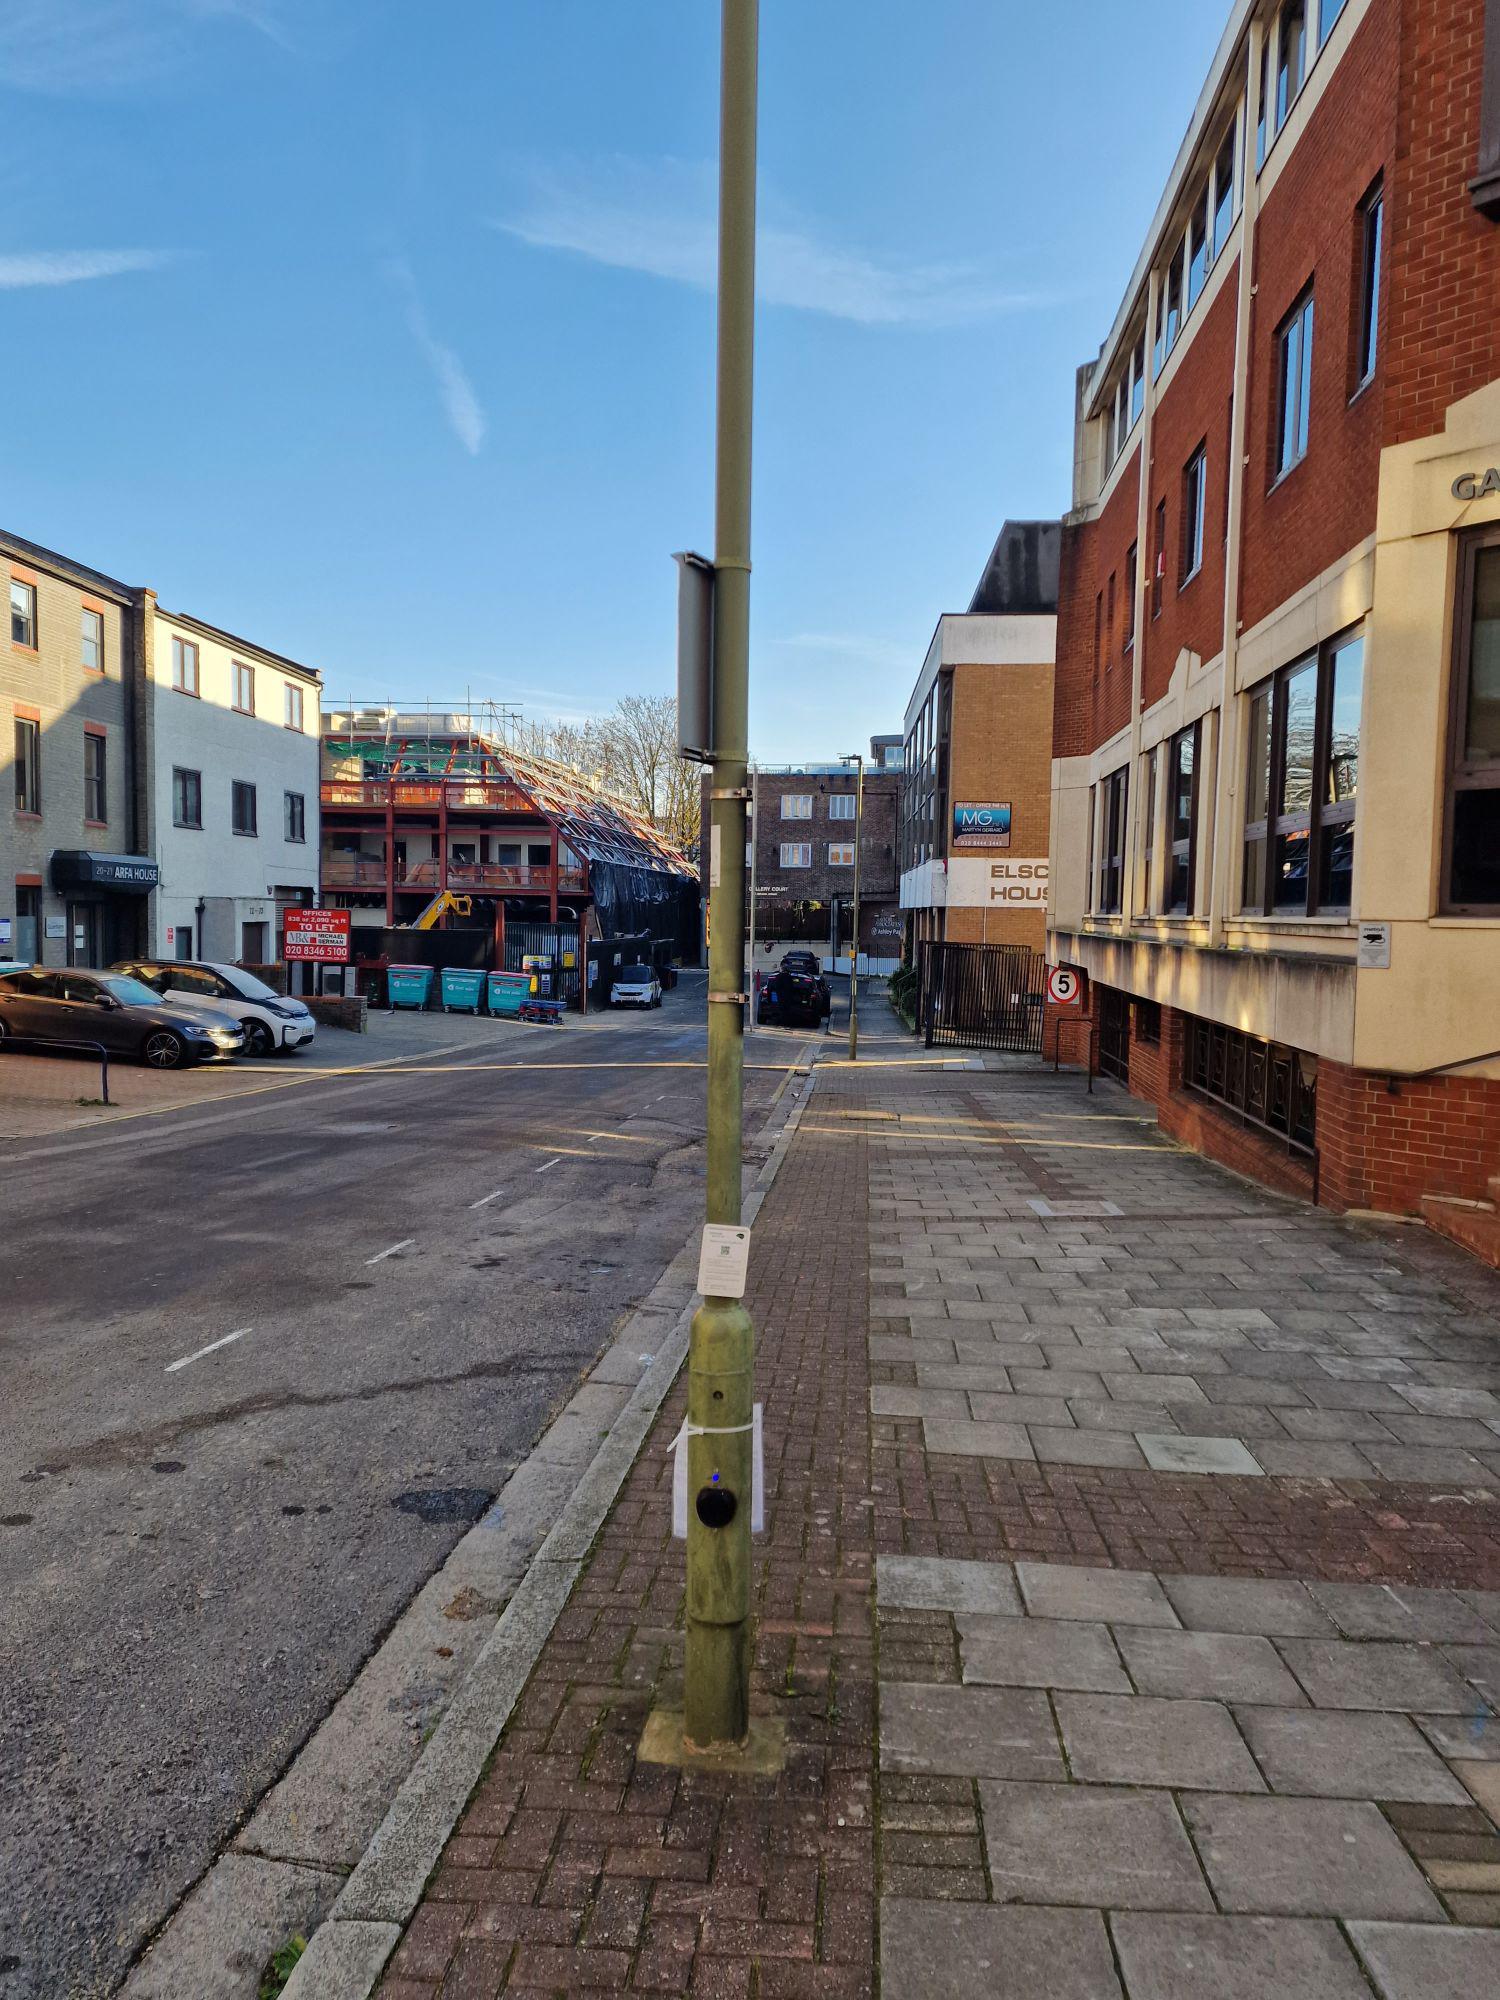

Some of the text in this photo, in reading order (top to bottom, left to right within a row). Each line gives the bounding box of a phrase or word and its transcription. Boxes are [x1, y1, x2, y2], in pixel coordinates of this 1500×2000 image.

[1451, 468, 1500, 500] GA
[962, 810, 992, 826] MG
[114, 866, 133, 879] ARFA
[134, 867, 157, 881] HOUSE
[299, 923, 335, 932] TO LET
[285, 945, 348, 956] 020 8346 5100
[1058, 975, 1070, 994] 5
